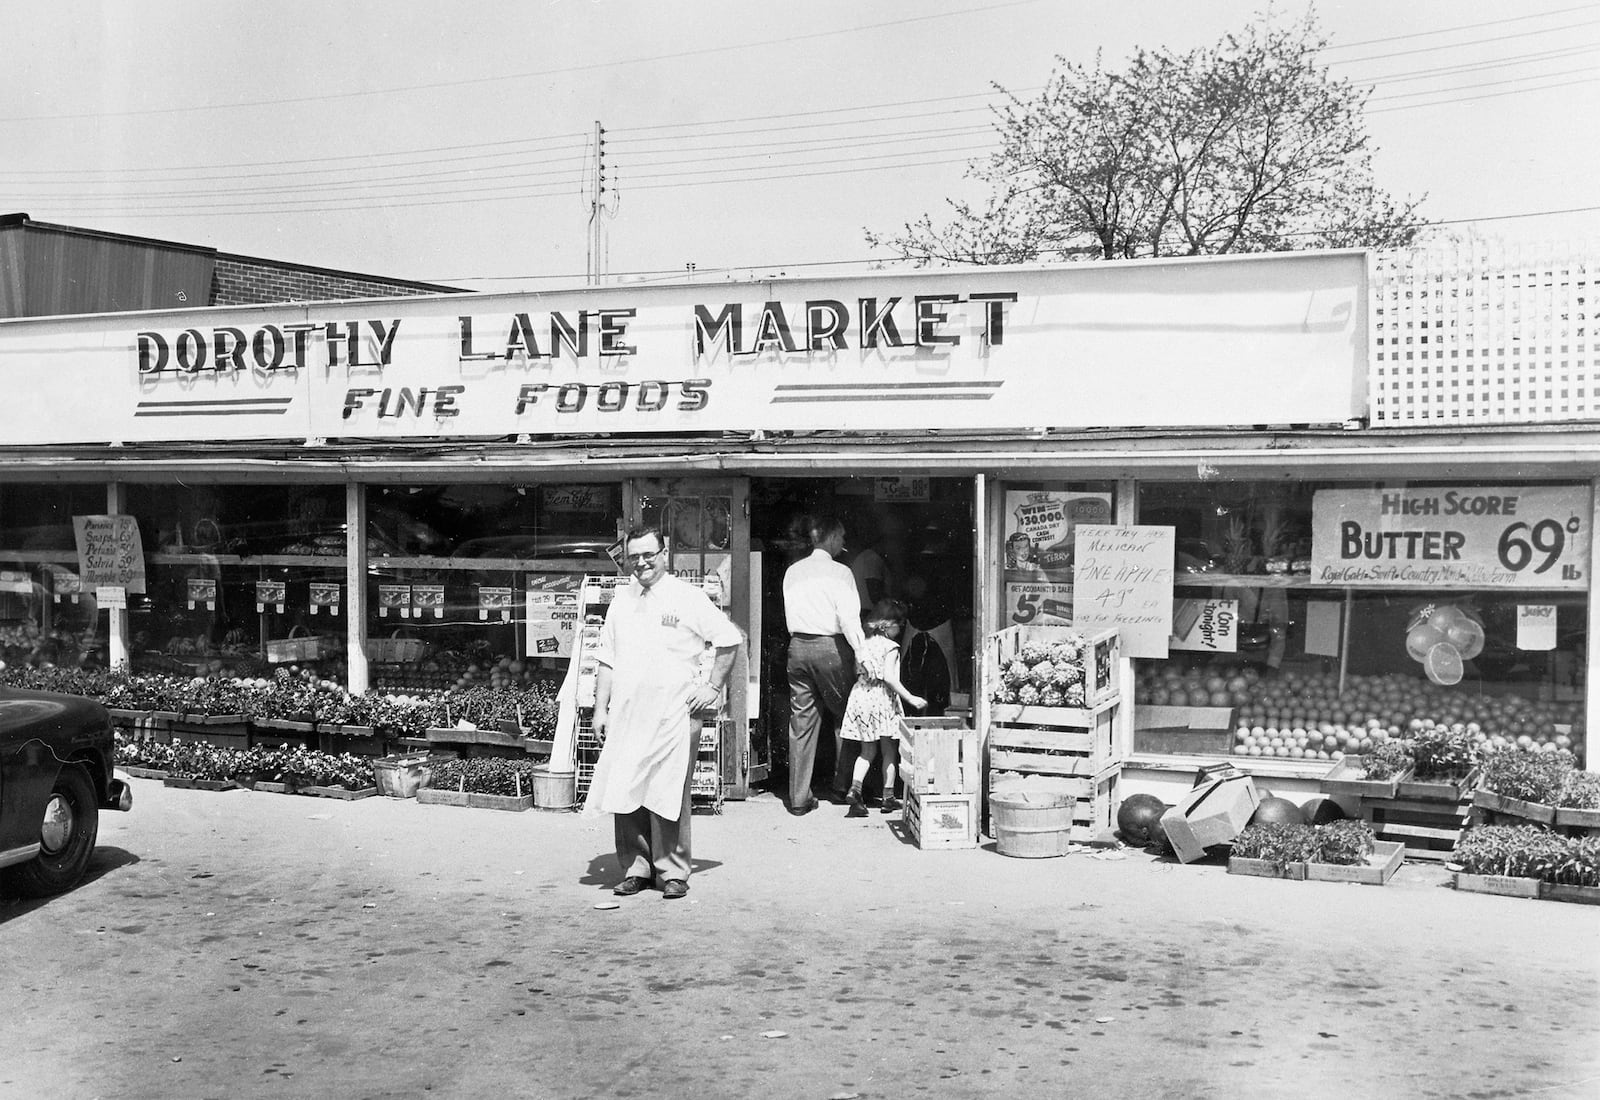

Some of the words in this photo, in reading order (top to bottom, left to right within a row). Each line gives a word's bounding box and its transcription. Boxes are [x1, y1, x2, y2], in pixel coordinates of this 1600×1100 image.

[137, 319, 401, 373] DOROTHY
[458, 308, 637, 361] LANE
[694, 292, 1018, 355] MARKET
[342, 385, 465, 419] FINE
[515, 379, 712, 415] FOODS
[1381, 494, 1439, 515] HIGH
[1444, 491, 1518, 516] SCORE
[1026, 524, 1048, 532] CANADA
[1341, 521, 1466, 560] BUTTER
[560, 621, 573, 630] PIE
[1199, 602, 1217, 648] tonight!
[1217, 612, 1234, 636] Corn
